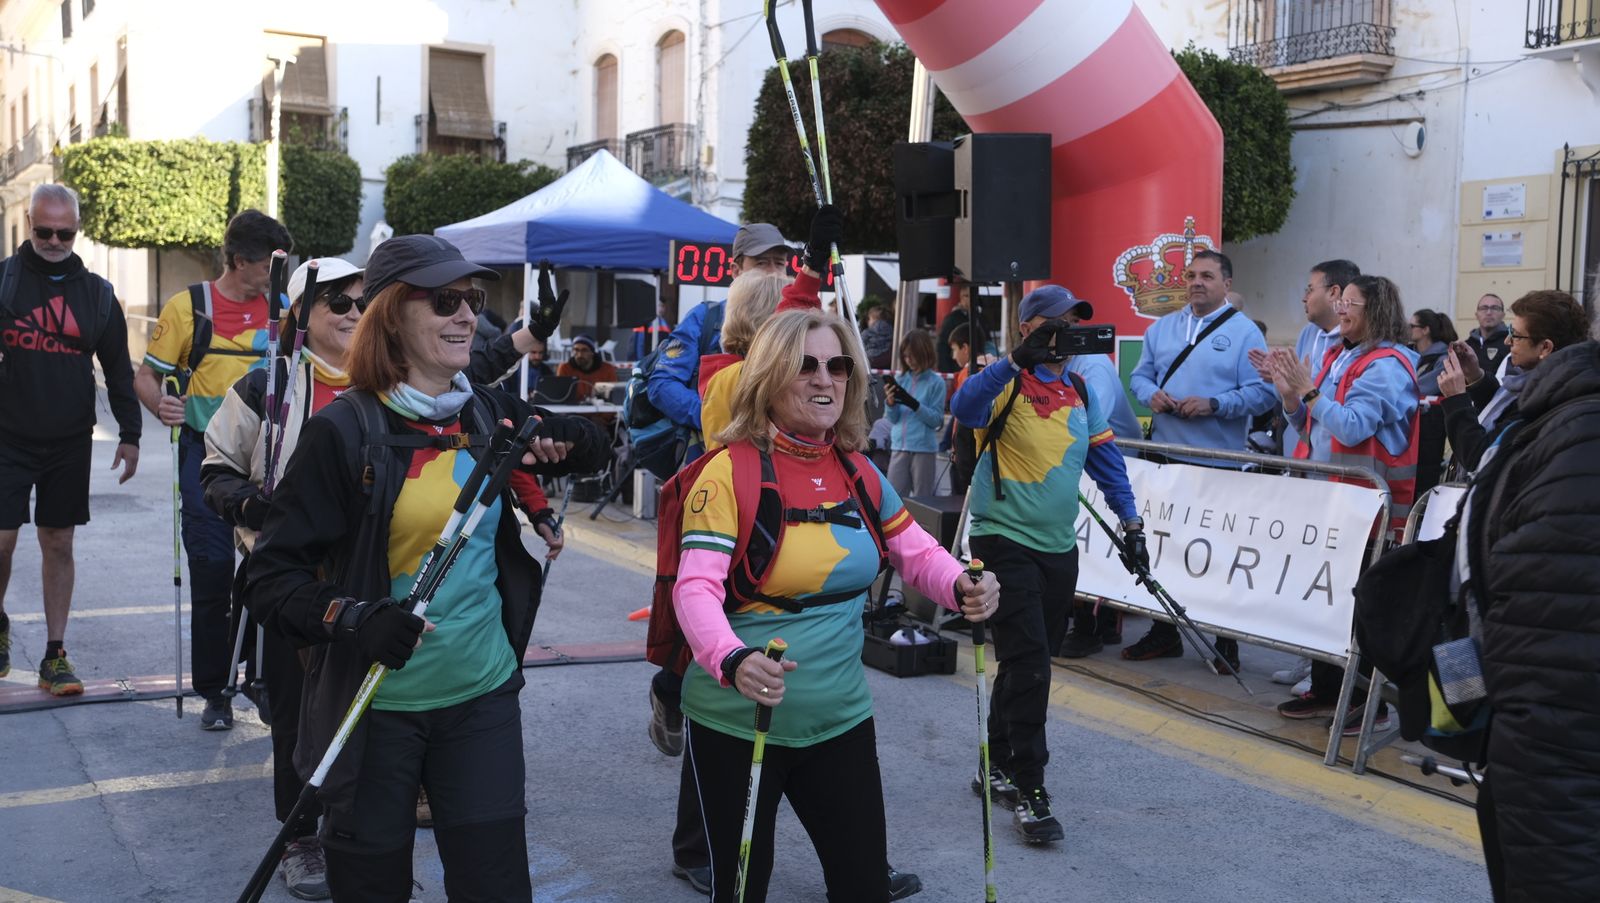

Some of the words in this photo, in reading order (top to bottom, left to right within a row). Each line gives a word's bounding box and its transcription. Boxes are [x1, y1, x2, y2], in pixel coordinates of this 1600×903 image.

[2, 328, 81, 354] adid
[1086, 487, 1285, 540] UAMIENTO
[1302, 524, 1340, 550] DE
[1076, 516, 1334, 607] ATORIA
